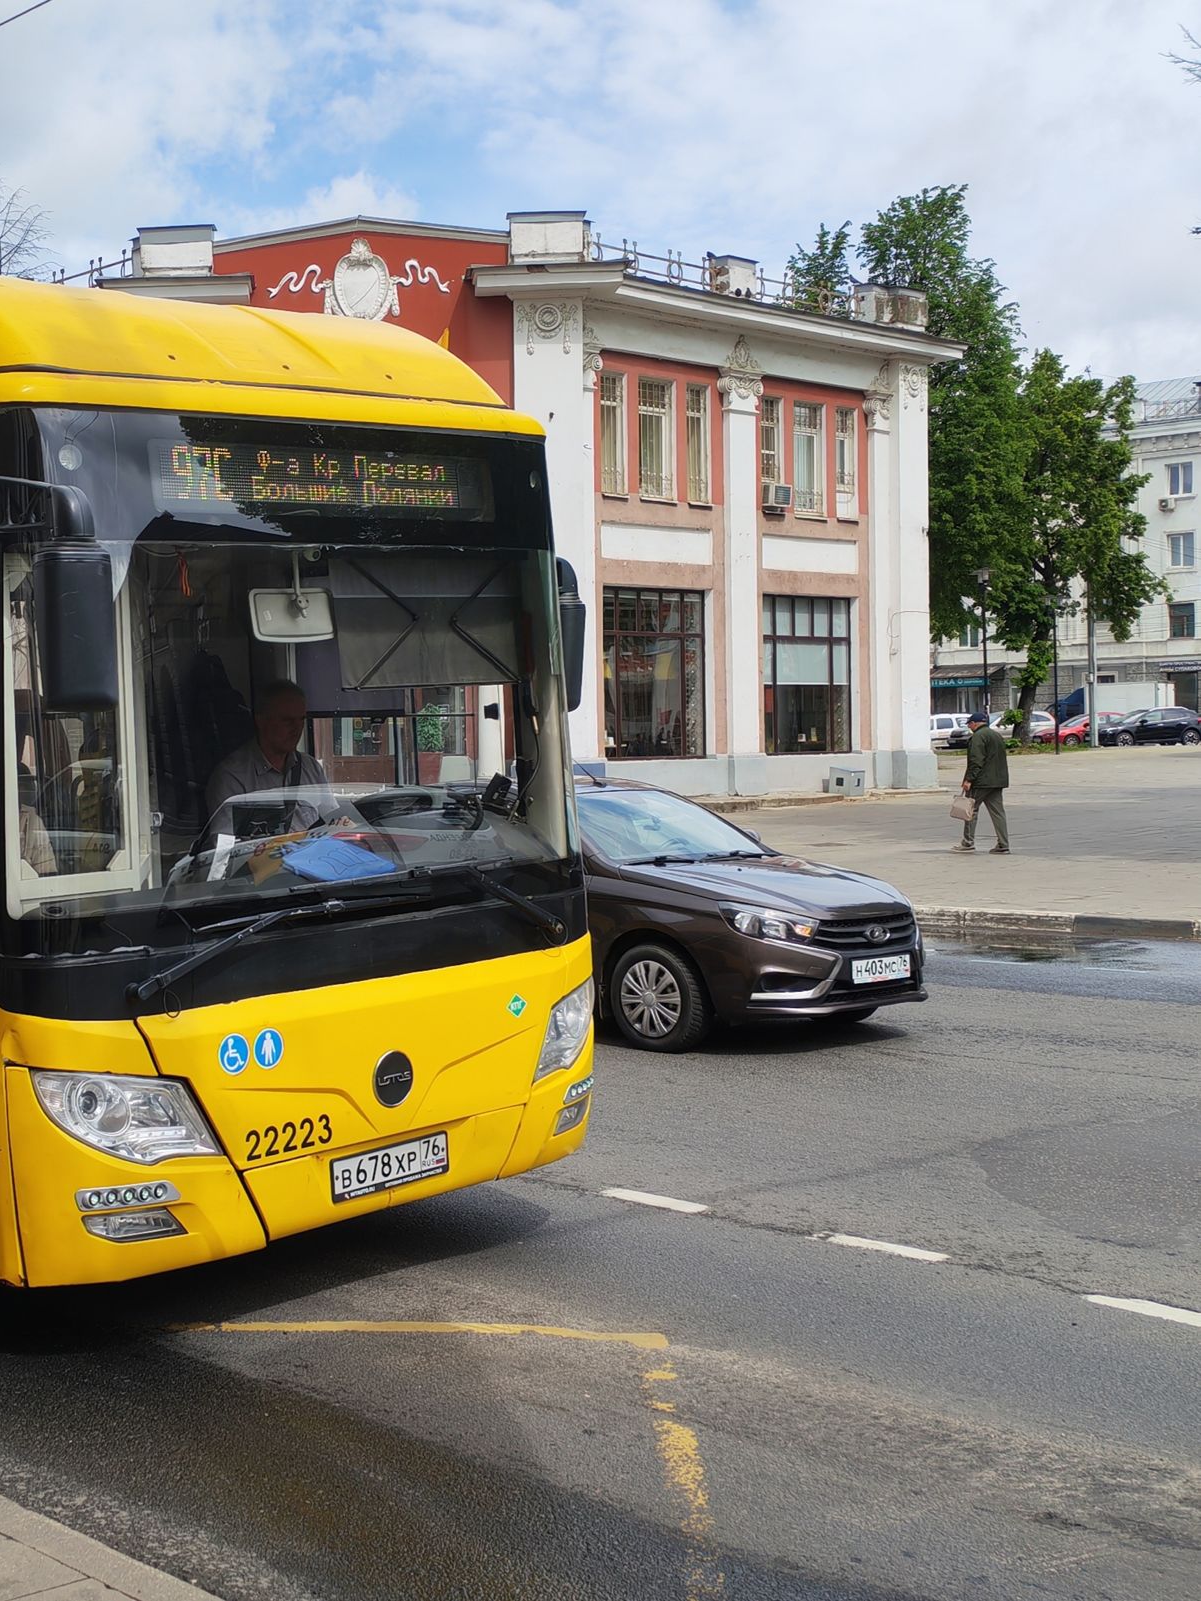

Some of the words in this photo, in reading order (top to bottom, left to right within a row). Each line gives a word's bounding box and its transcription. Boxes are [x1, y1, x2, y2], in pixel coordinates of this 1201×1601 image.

[313, 453, 341, 479] Кр
[354, 455, 446, 484] Перевал
[252, 476, 348, 502] Большие
[363, 481, 454, 505] Полянки
[245, 1114, 333, 1161] 22223
[341, 1151, 417, 1189] В678ХР
[422, 1138, 440, 1160] 76
[422, 1159, 435, 1167] RUS
